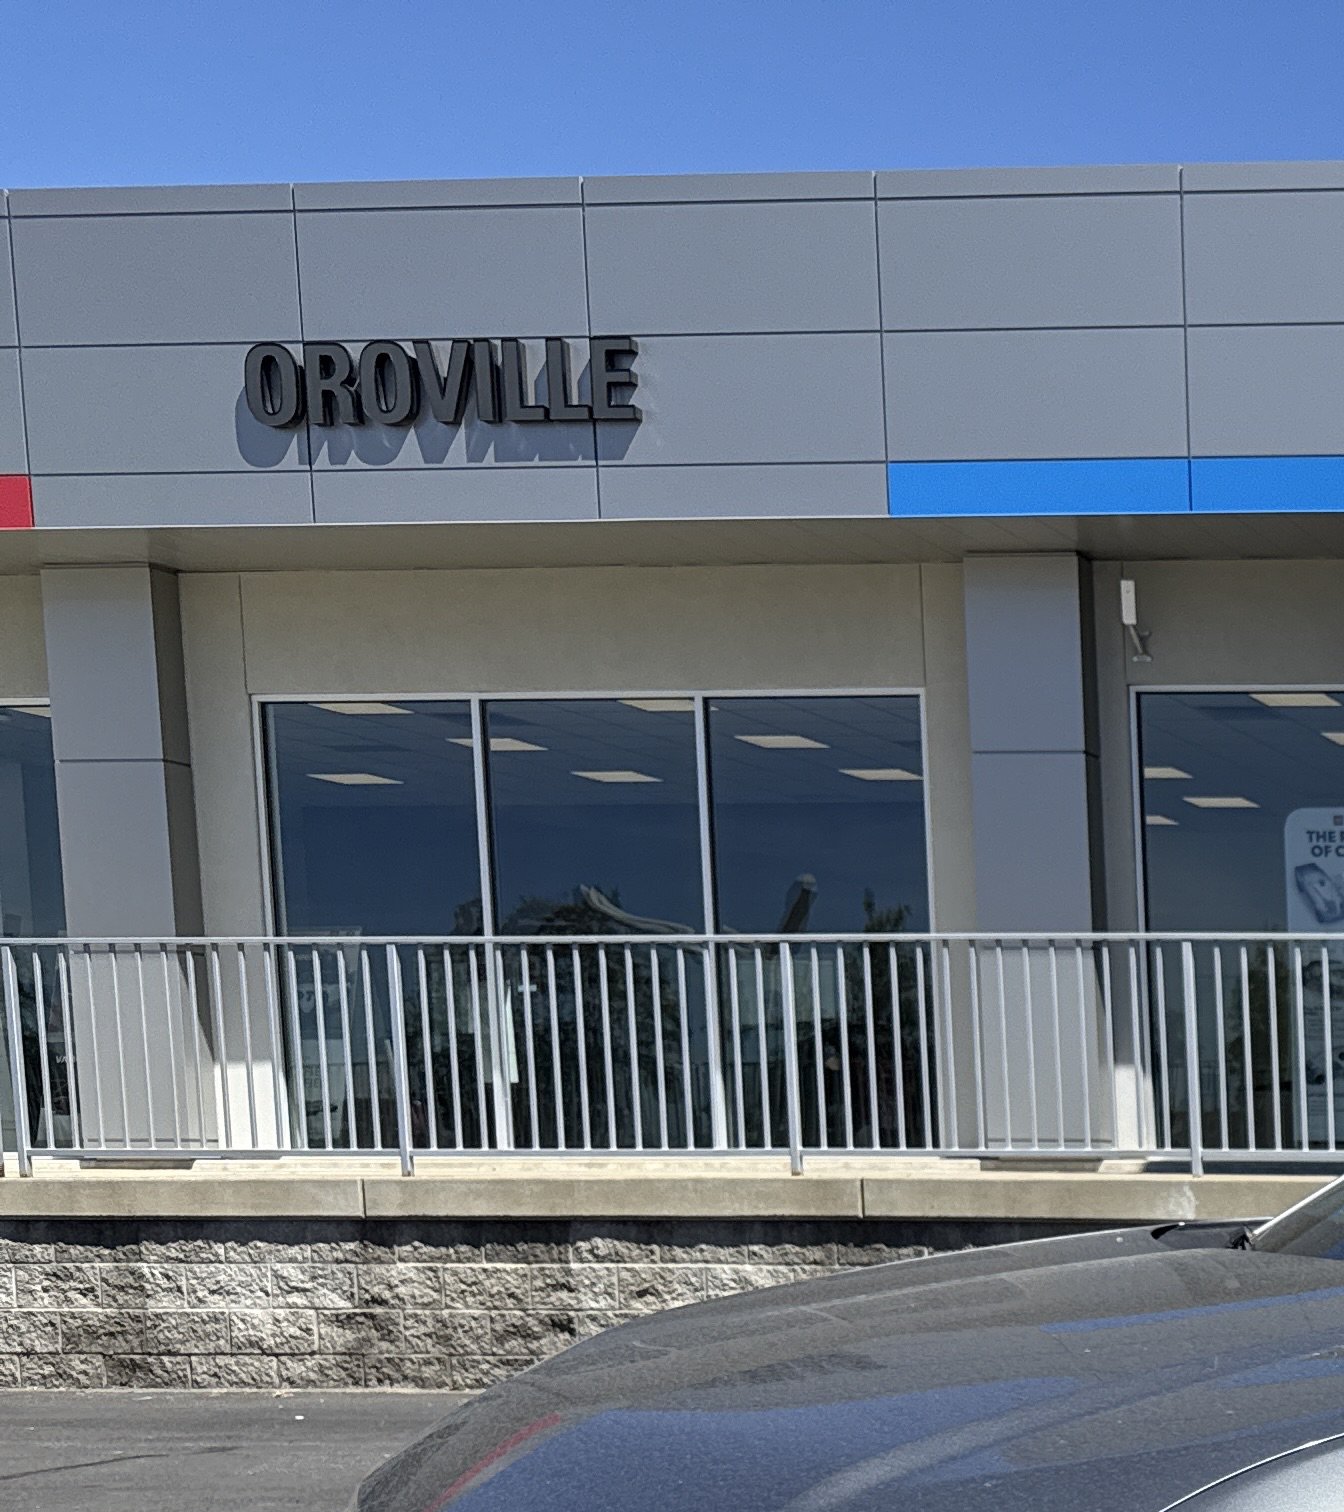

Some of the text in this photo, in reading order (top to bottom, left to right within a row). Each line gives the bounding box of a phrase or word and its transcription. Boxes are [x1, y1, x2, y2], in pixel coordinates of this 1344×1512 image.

[243, 336, 642, 428] OROVILLE
[1306, 830, 1337, 843] THE
[1311, 845, 1332, 857] OF
